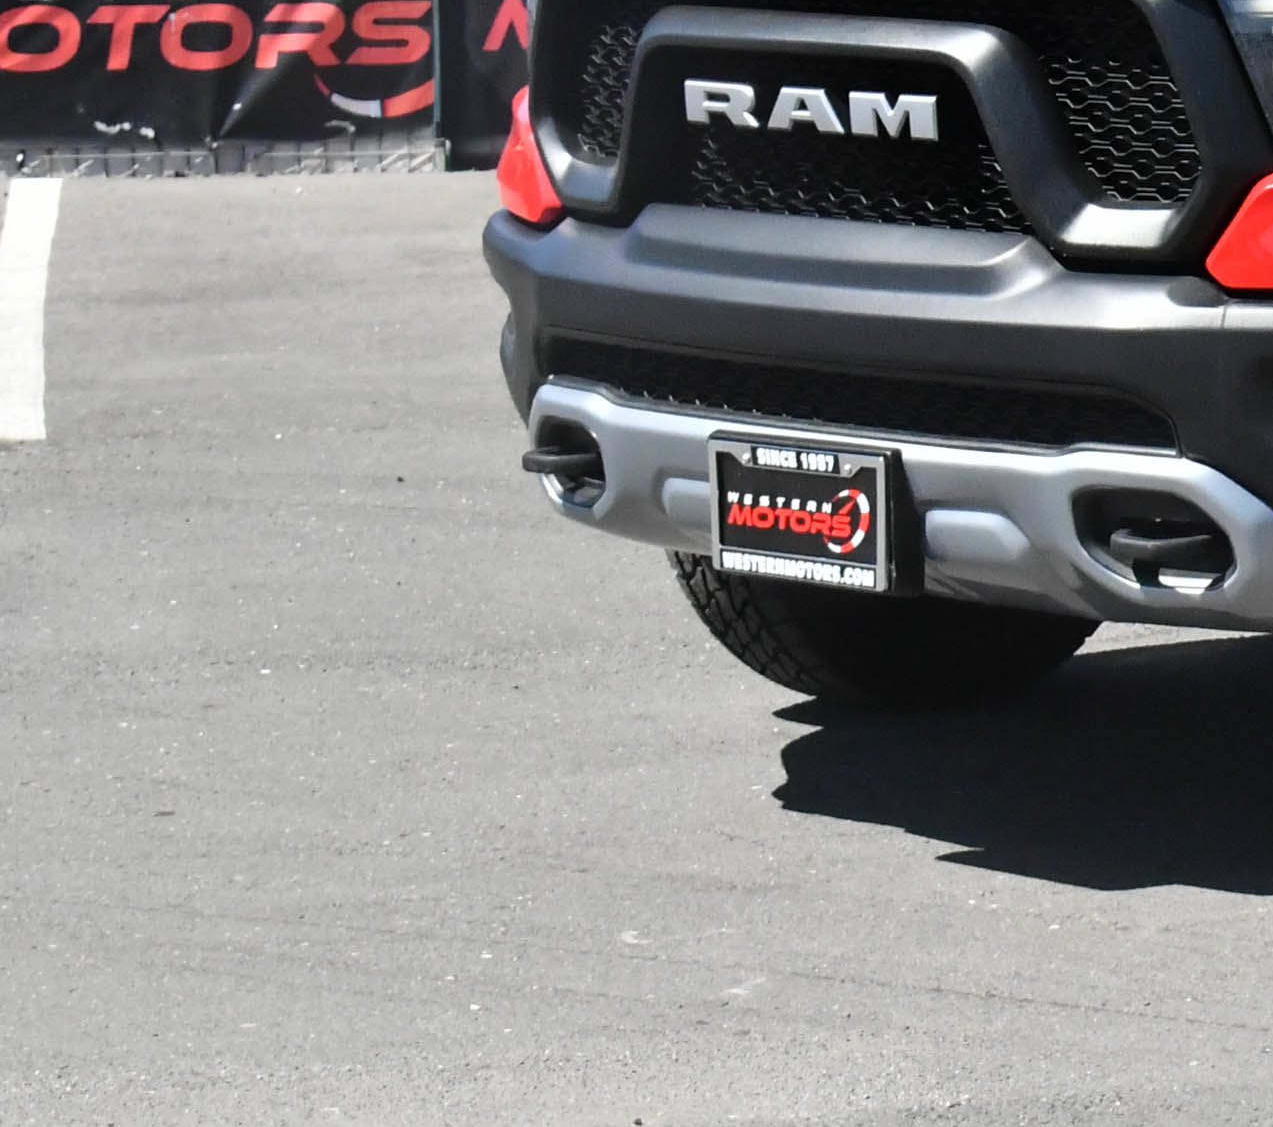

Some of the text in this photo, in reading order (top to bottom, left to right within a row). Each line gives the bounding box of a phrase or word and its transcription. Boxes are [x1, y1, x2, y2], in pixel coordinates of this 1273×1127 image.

[684, 79, 938, 141] RAM
[756, 447, 798, 469] SINCE
[727, 491, 833, 514] WESTERN
[727, 502, 853, 539] MOTORS
[722, 550, 875, 588] WESTERNMOTORS.COM
